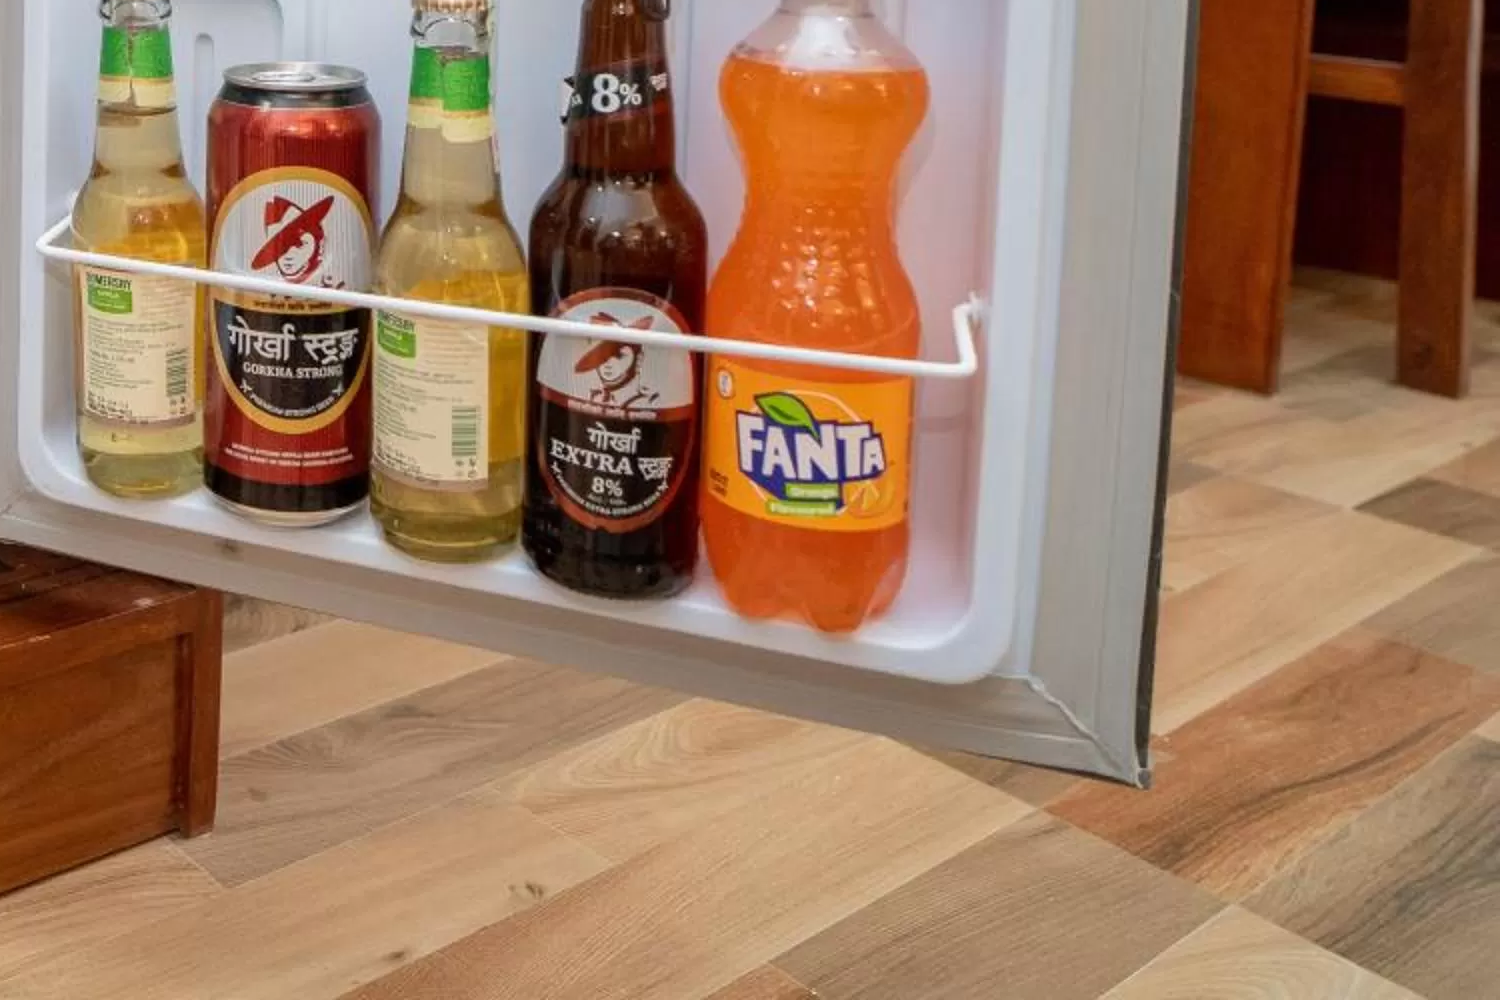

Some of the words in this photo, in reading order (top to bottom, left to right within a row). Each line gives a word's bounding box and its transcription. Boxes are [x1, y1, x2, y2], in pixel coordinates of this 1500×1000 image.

[591, 73, 642, 113] 8%
[243, 361, 293, 378] GORKHA
[296, 363, 344, 379] STRONG
[551, 438, 634, 477] EXTRA
[737, 413, 884, 481] FANTA
[591, 476, 623, 498] 8%
